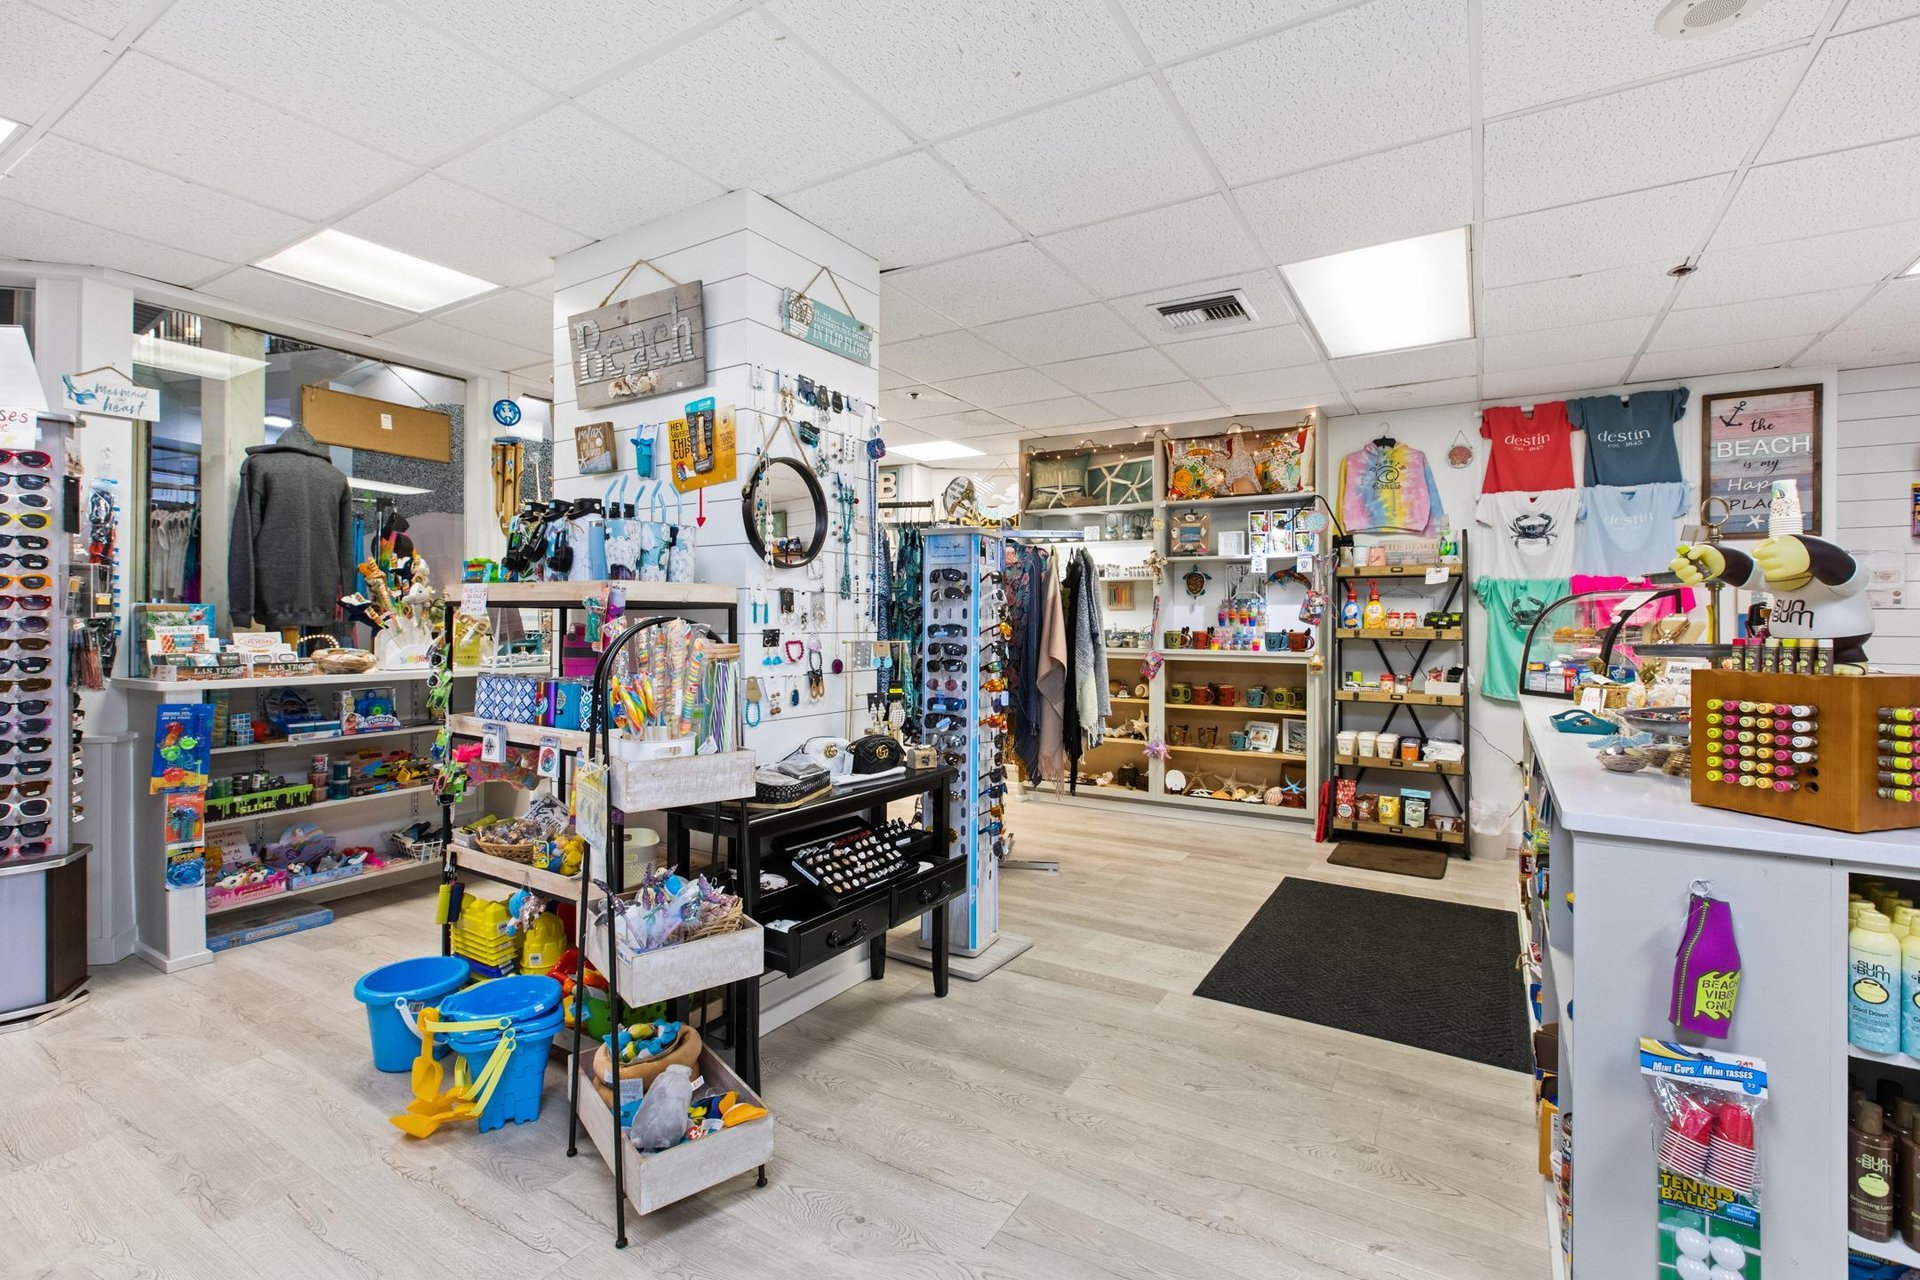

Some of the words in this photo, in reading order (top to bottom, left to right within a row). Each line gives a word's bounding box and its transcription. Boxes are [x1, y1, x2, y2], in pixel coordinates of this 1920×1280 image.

[573, 295, 697, 387] Beach
[670, 422, 684, 432] HEY
[1749, 417, 1775, 433] the
[1504, 433, 1551, 447] destin
[1597, 429, 1651, 443] destin
[1716, 435, 1811, 458] BEACH
[1743, 460, 1752, 469] is
[1760, 459, 1781, 475] my
[1727, 478, 1773, 492] Hap
[194, 667, 213, 675] LAS
[214, 665, 244, 674] VEGAS
[268, 664, 286, 672] LAS
[288, 662, 317, 671] VEGAS
[239, 800, 276, 815] SLIME
[1853, 1005, 1868, 1014] Cool
[1868, 1009, 1889, 1018] Down
[1661, 1173, 1736, 1202] TENNIS
[1661, 1186, 1718, 1211] BALLS
